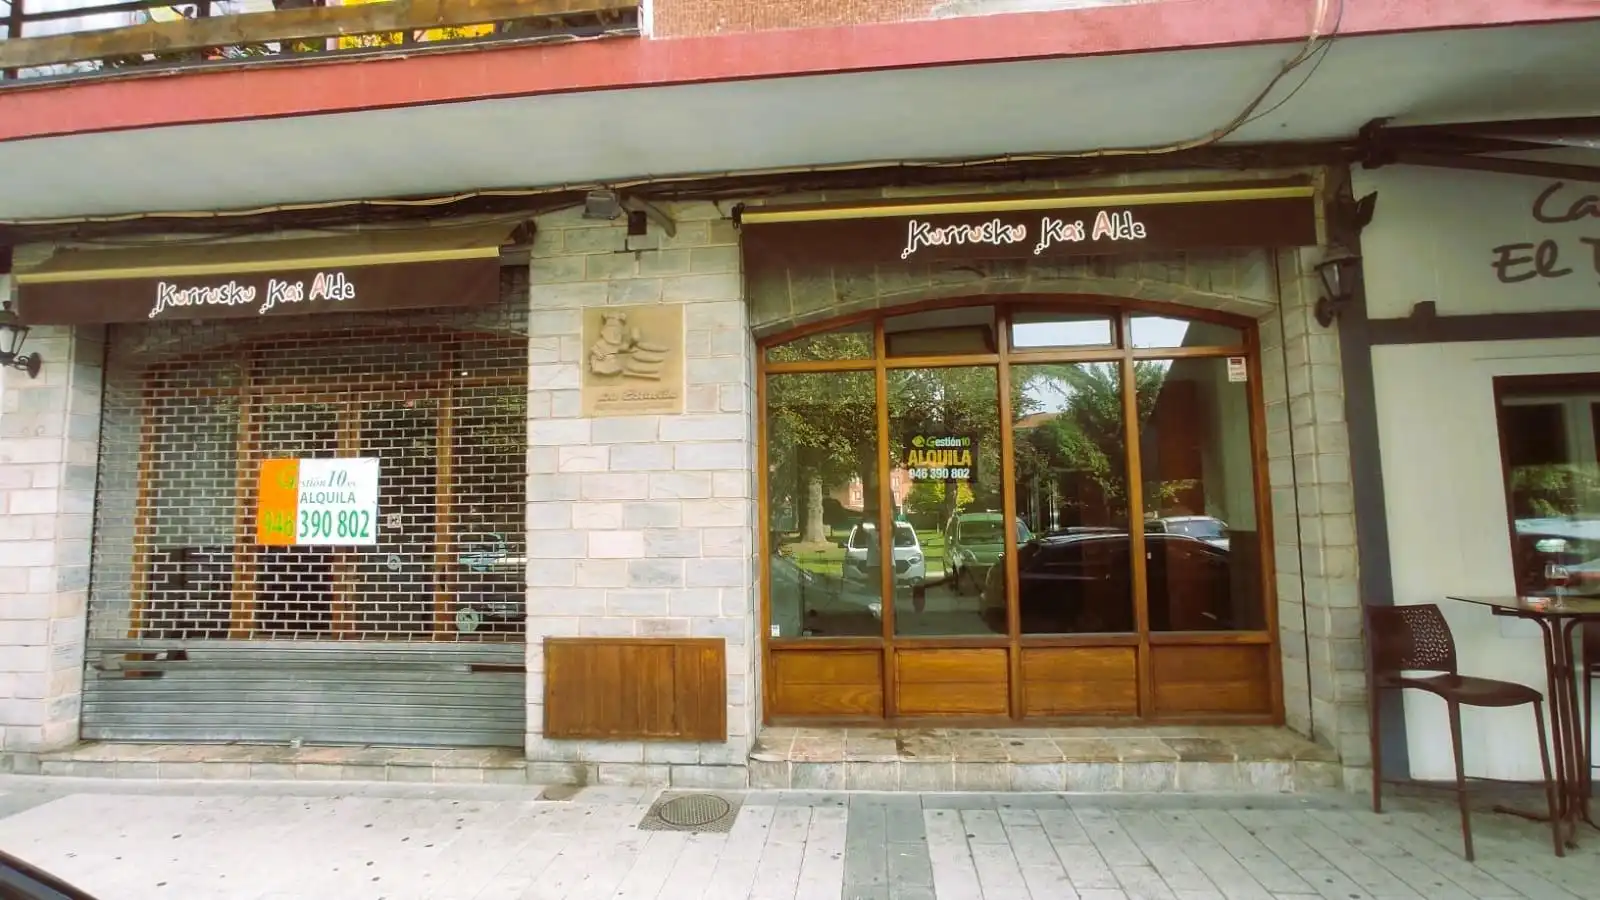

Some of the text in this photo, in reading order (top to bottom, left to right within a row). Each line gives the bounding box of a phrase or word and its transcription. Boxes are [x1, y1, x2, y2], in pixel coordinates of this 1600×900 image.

[901, 211, 1147, 259] Kurrusku Kai Alde
[1491, 239, 1573, 283] El
[149, 272, 355, 318] Kurrusku Kai Alde
[908, 449, 973, 466] ALQUILA
[909, 468, 970, 479] 946 390 802
[300, 491, 356, 504] ALQUILA
[264, 510, 369, 538] 946 390 802
